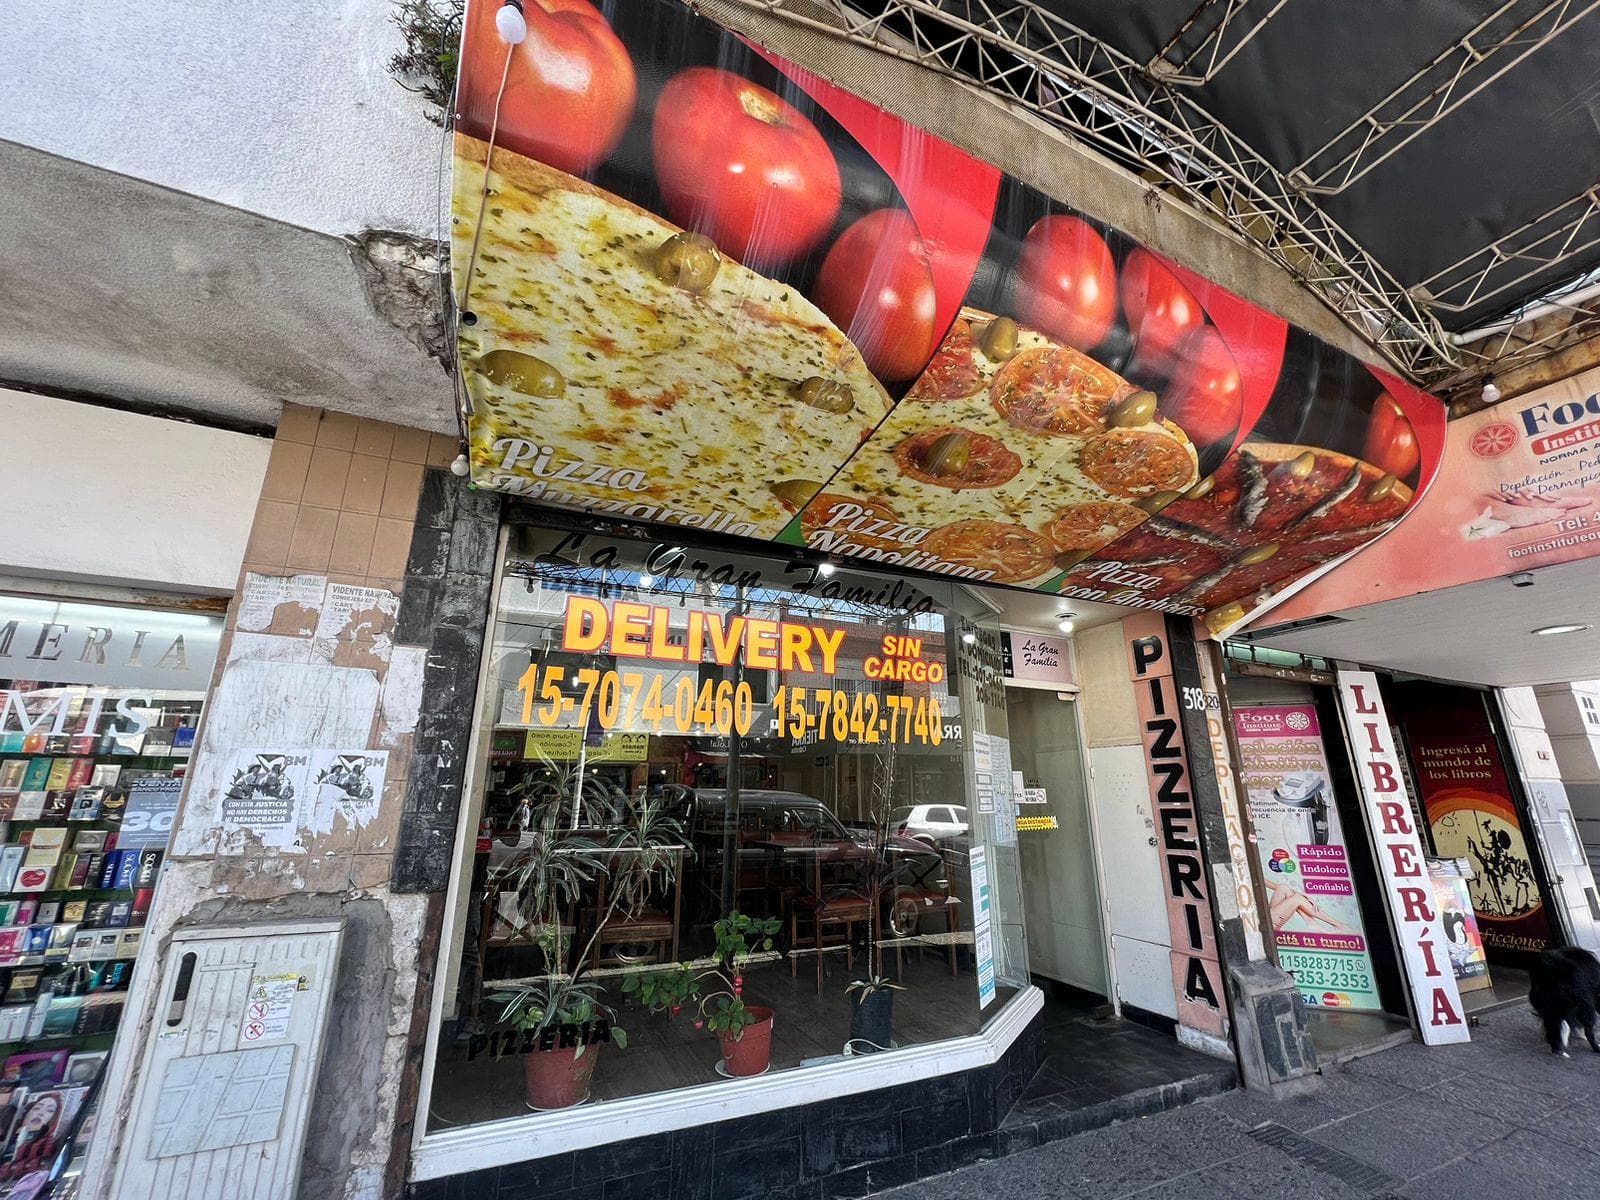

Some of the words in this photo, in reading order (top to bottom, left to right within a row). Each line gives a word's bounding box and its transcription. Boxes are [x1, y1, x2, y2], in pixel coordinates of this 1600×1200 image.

[492, 437, 649, 492] Pizza
[1540, 447, 1588, 465] NORMA
[1500, 470, 1565, 494] Depilación
[828, 503, 932, 545] Pizza
[1555, 516, 1588, 531] Tel:
[535, 532, 622, 569] La
[646, 543, 762, 590] Gran
[784, 560, 937, 615] Familia
[1086, 561, 1163, 590] Pizza
[333, 586, 364, 597] VIDENTE
[1057, 585, 1107, 600] con
[561, 595, 847, 675] DELIVERY
[883, 634, 923, 660] SIN
[1022, 640, 1036, 652] La
[1038, 642, 1059, 656] Gran
[1023, 653, 1058, 667] Familia
[863, 656, 944, 683] CARGO
[517, 663, 753, 737] 15-7074-0460
[773, 685, 943, 746] 15-7842-7740
[1182, 686, 1205, 711] 318
[1239, 713, 1281, 721] Foot
[1242, 738, 1321, 756] pilación
[1421, 745, 1470, 758] Ingresá
[1474, 744, 1487, 754] al
[1423, 756, 1470, 768] mundo
[1474, 756, 1492, 766] de
[1429, 770, 1448, 780] los
[1451, 768, 1492, 779] libros
[1132, 636, 1220, 1010] PIZZERIA
[1300, 847, 1342, 858] Rápido
[1350, 685, 1462, 1027] LIBRERÍA
[1302, 864, 1347, 874] Indoloro
[1305, 881, 1350, 893] Confiable
[1276, 934, 1299, 946] citá
[1303, 936, 1316, 947] tu
[1320, 936, 1361, 949] turno!
[1478, 927, 1546, 949] ficciones
[467, 1020, 611, 1062] PIZZERIA
